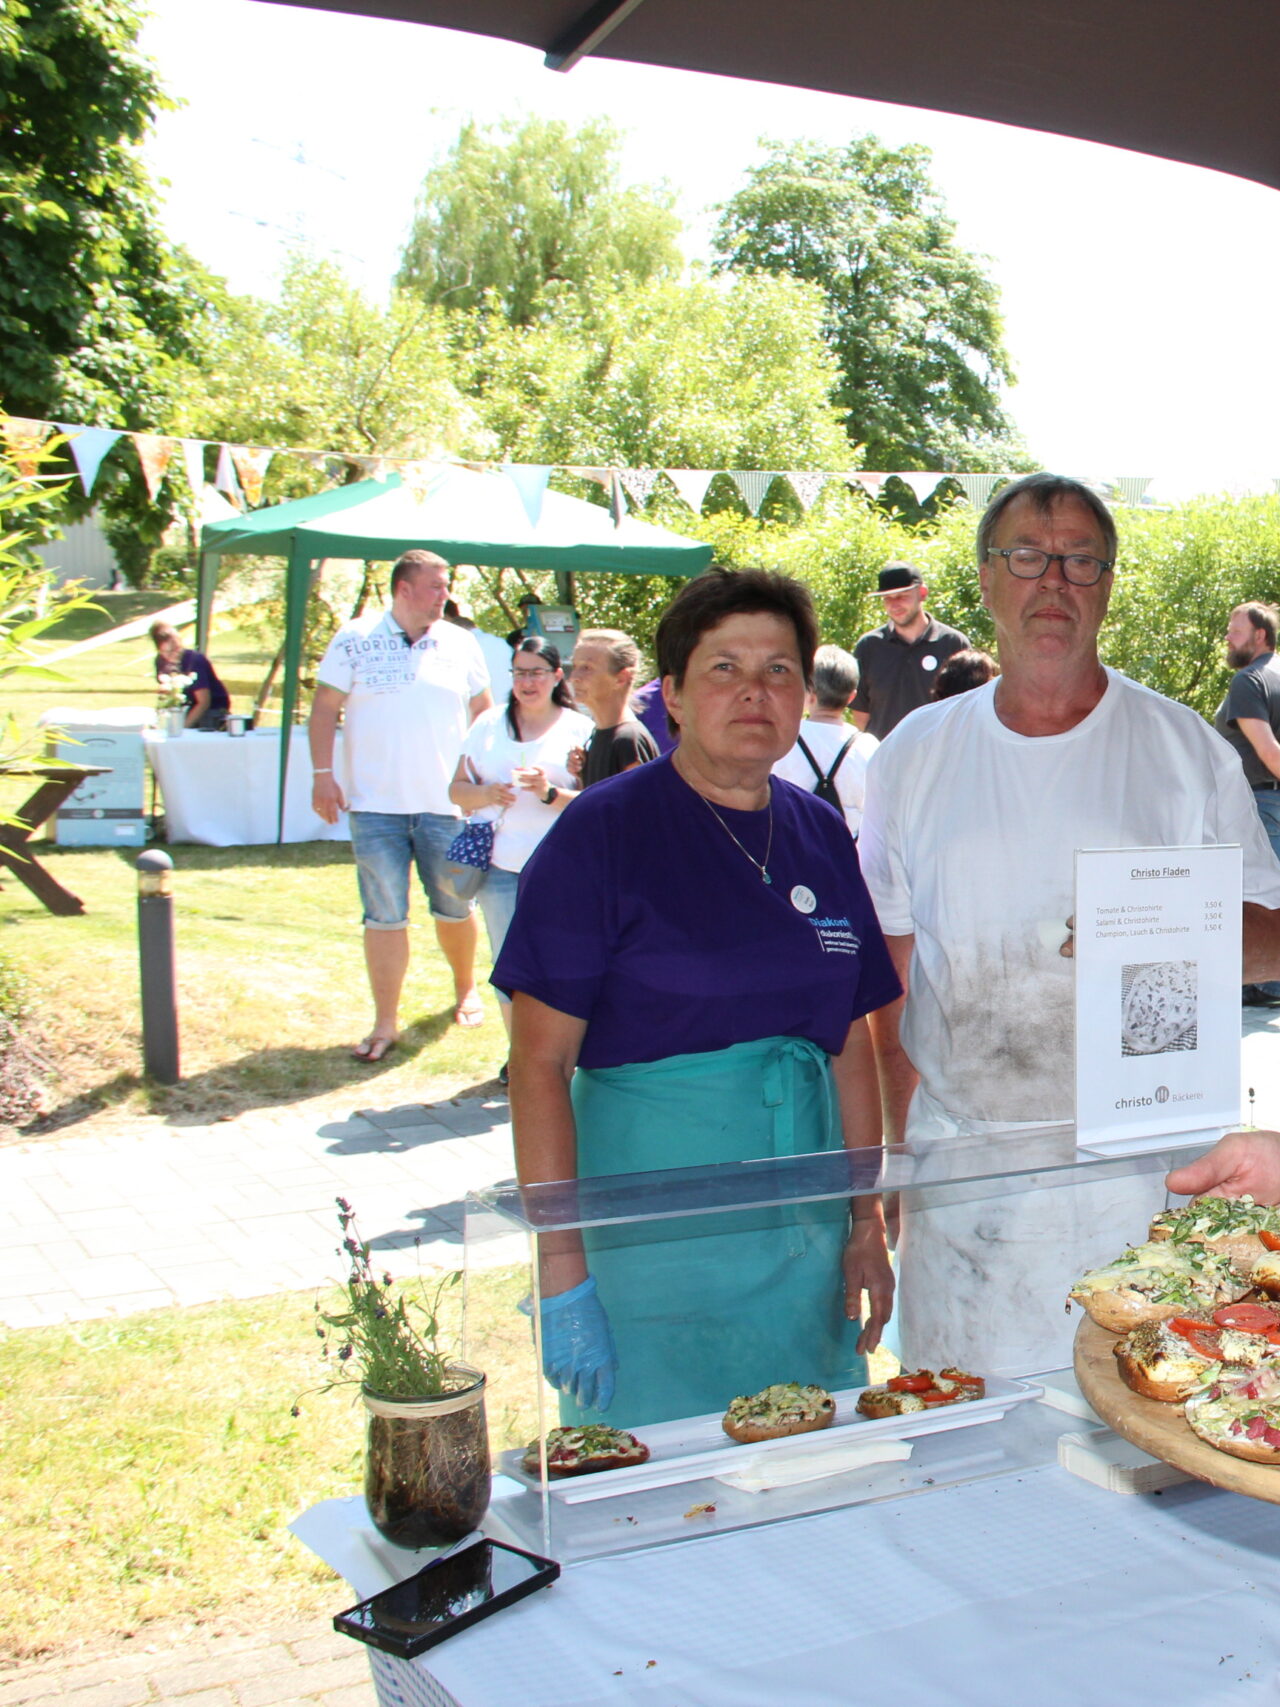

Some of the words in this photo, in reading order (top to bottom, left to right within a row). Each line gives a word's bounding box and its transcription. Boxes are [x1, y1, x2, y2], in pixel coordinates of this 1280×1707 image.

[1130, 868, 1161, 878] Christo
[1162, 867, 1190, 876] Fladen
[1096, 906, 1119, 915] Tomate
[1095, 918, 1116, 927] Salami
[1130, 928, 1148, 937] Lauch
[1114, 1096, 1153, 1110] christo
[1172, 1092, 1204, 1103] Bäckerei
